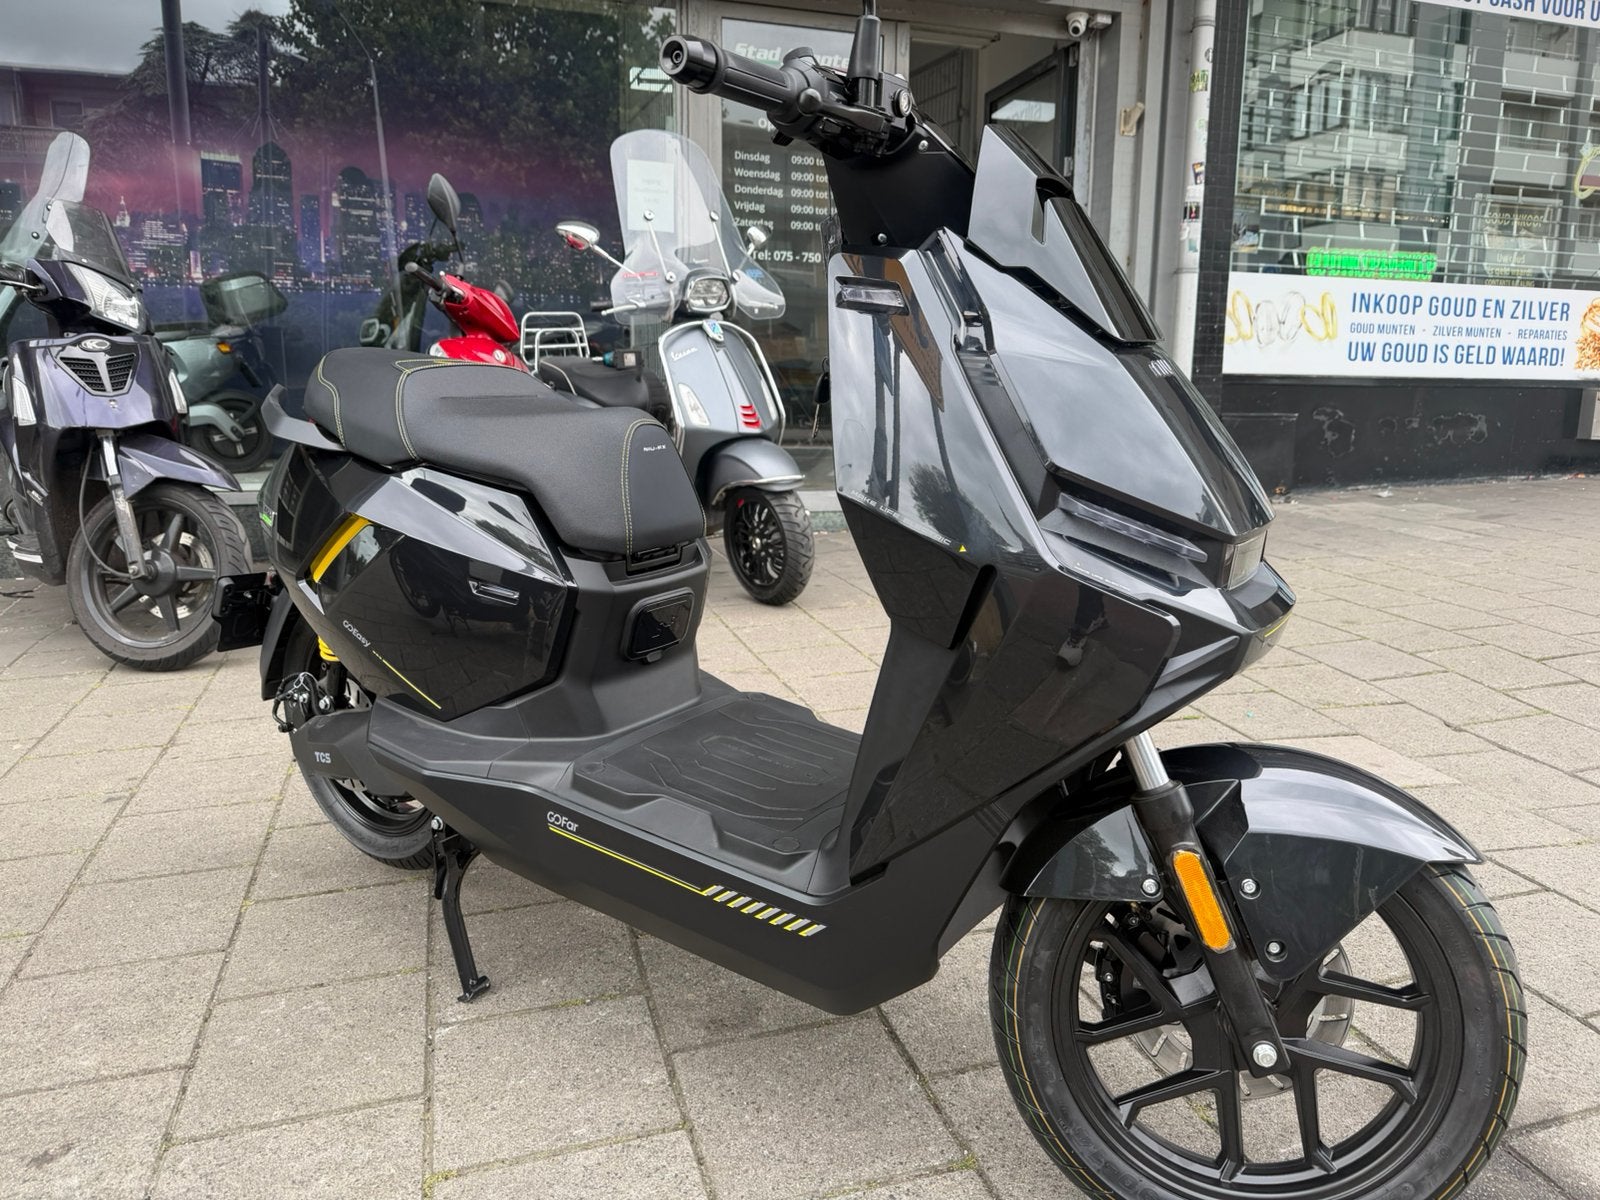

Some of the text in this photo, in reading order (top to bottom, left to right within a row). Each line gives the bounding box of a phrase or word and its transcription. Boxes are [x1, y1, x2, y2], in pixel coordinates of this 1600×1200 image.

[735, 43, 782, 60] Stad
[734, 151, 825, 166] Dinsdag 09:00 to
[734, 167, 829, 183] Woensdag 09:00 tot
[734, 184, 828, 199] Donderdag 09:00 tot
[734, 201, 828, 216] Vrijdag 09:00 tot
[791, 221, 814, 231] 09:00
[752, 250, 772, 261] Tel:
[774, 250, 794, 262] 075
[802, 252, 822, 263] 750
[1352, 292, 1571, 322] INKOOP GOUD EN ZILVER
[1350, 322, 1375, 334] GOUD
[1377, 323, 1416, 335] MUNTEN
[1432, 325, 1463, 337] ZILVER
[1465, 326, 1502, 338] MUNTEN
[1517, 328, 1568, 341] REPARATIES
[1348, 341, 1565, 367] UW GOUD IS GELD WAARD!
[314, 751, 332, 764] TCS
